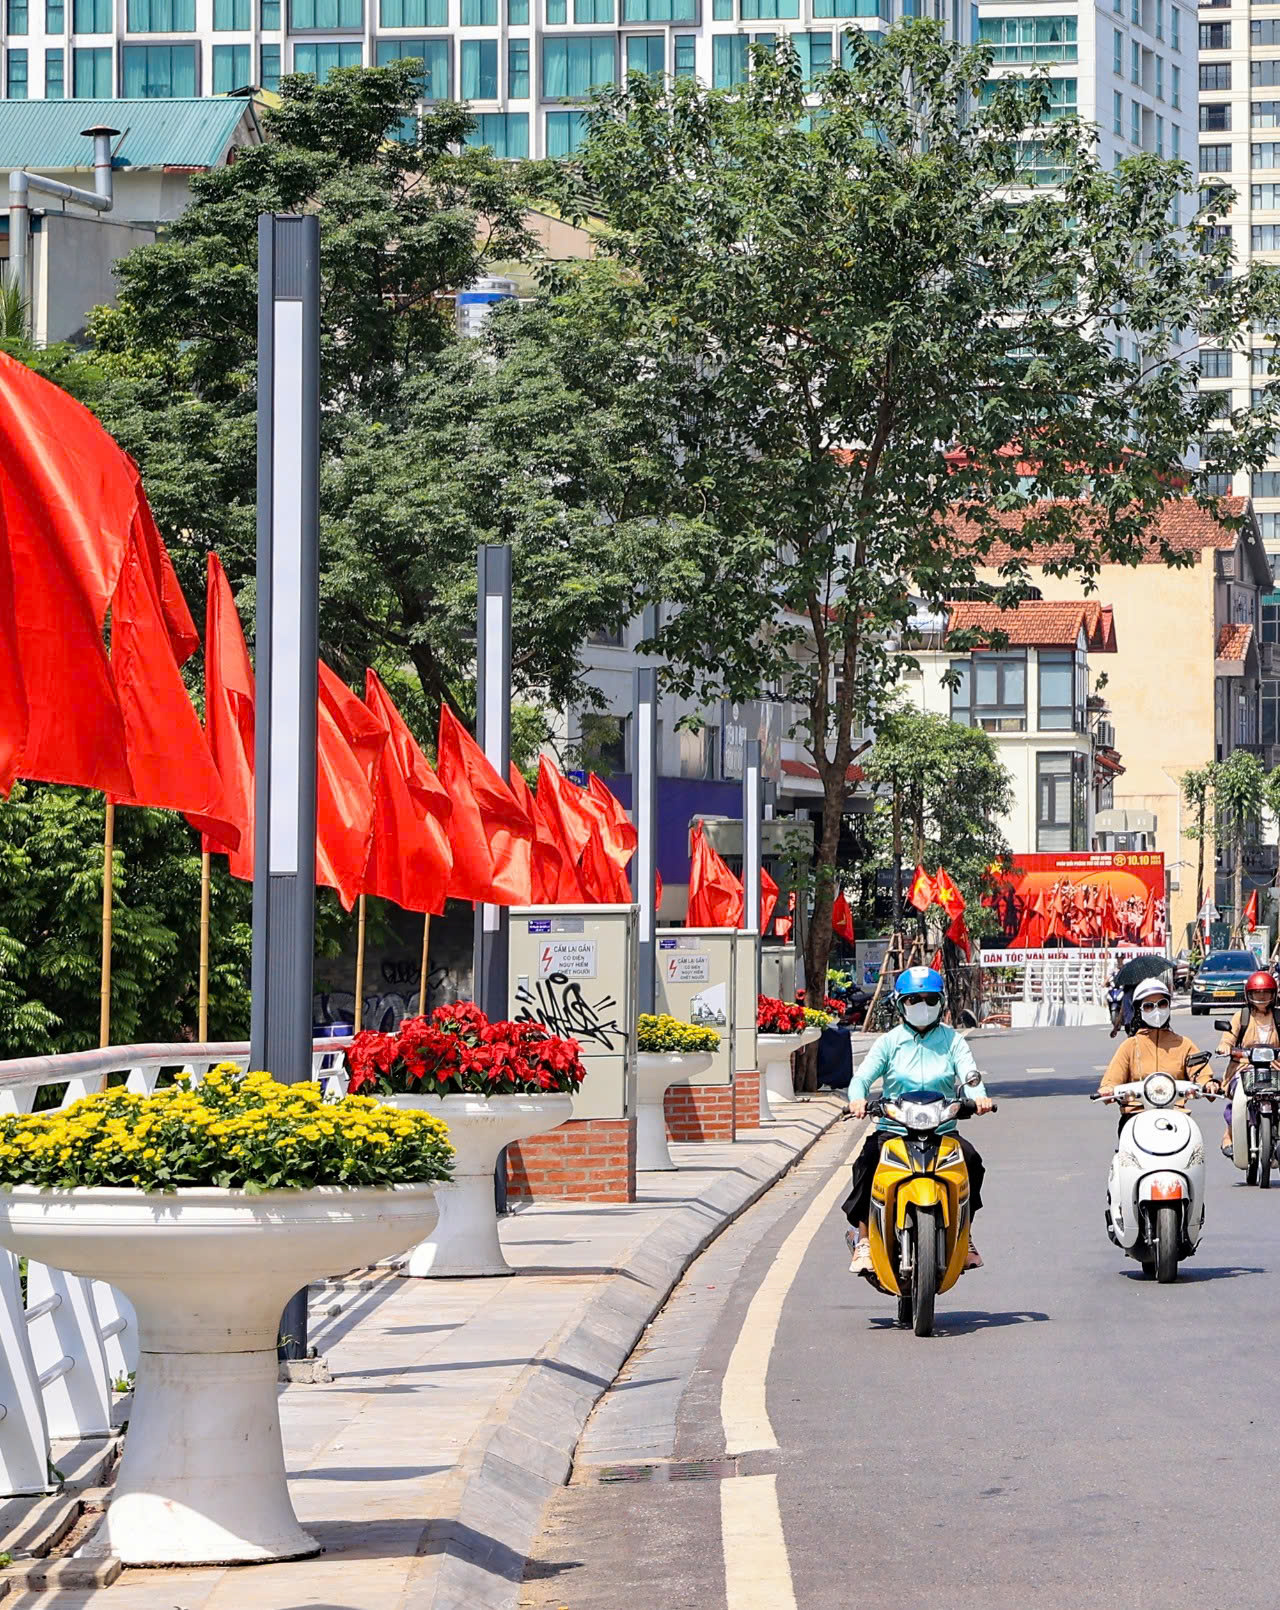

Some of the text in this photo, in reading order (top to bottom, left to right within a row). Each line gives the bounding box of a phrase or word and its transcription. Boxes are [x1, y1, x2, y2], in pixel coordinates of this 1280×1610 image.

[1127, 855, 1150, 866] 10.10
[554, 944, 567, 952] CẤM
[984, 952, 1002, 963] DÂN
